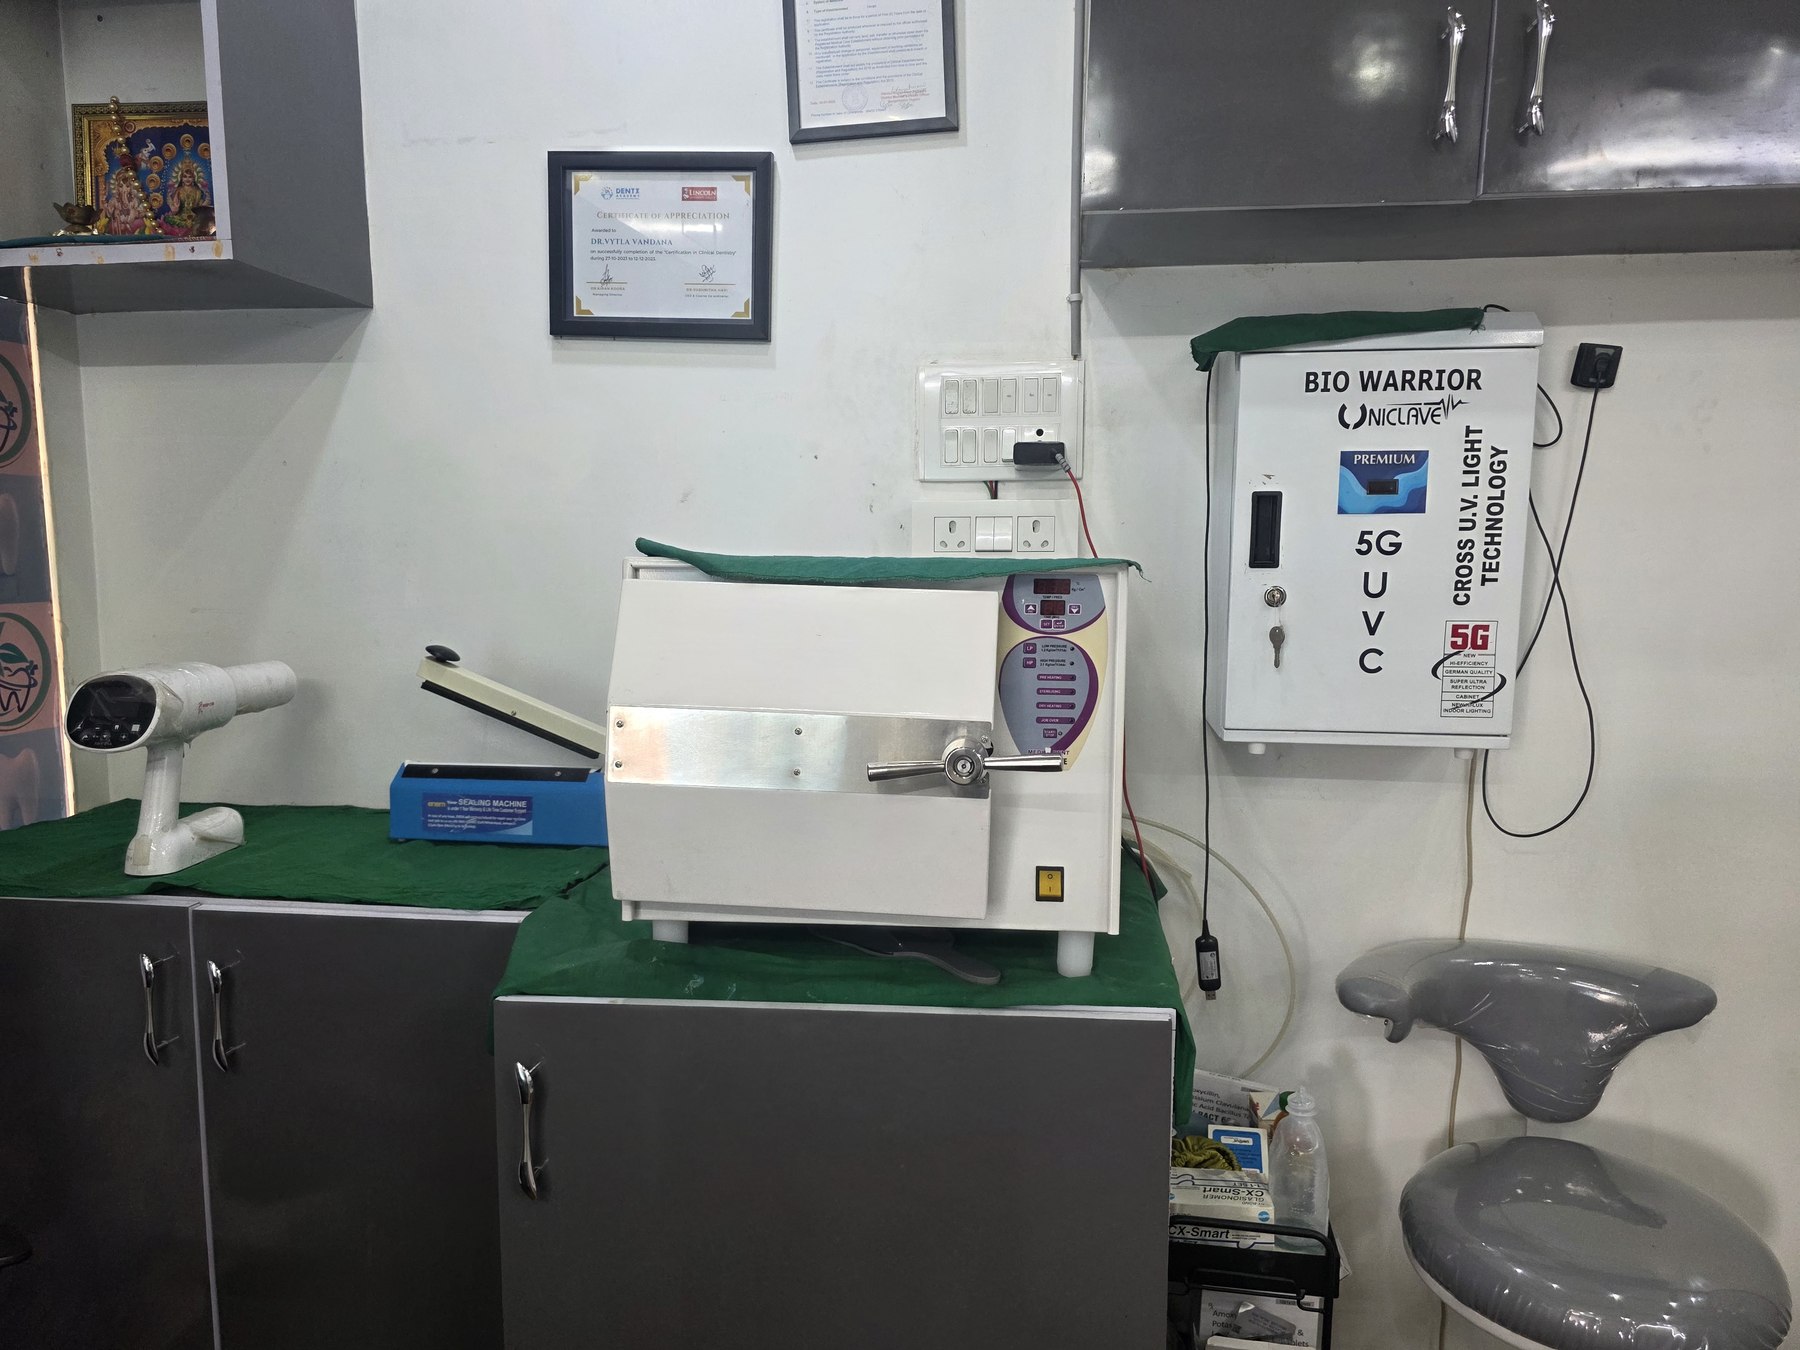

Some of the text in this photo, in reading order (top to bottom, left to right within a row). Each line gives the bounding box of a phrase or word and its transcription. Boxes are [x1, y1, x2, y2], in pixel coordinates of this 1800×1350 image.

[1304, 368, 1482, 393] BIO WARRIOR
[1353, 454, 1416, 465] PREMIUM
[1453, 425, 1484, 606] CROSS U.V. LIGHT
[1480, 446, 1508, 587] TECHNOLOGY
[1355, 530, 1402, 556] 5G
[1363, 572, 1388, 599] U
[1362, 611, 1385, 636] V
[1450, 624, 1490, 650] 5G
[1359, 648, 1384, 674] C
[458, 799, 491, 807] SEALING
[1193, 1089, 1220, 1098] oxycillin,
[1202, 1187, 1264, 1196] CX-Smart
[1202, 1194, 1264, 1202] GLASIONOMER
[1169, 1225, 1230, 1239] CX-Smart
[1212, 1320, 1233, 1328] Potas
[1213, 1310, 1236, 1319] Amoxy
